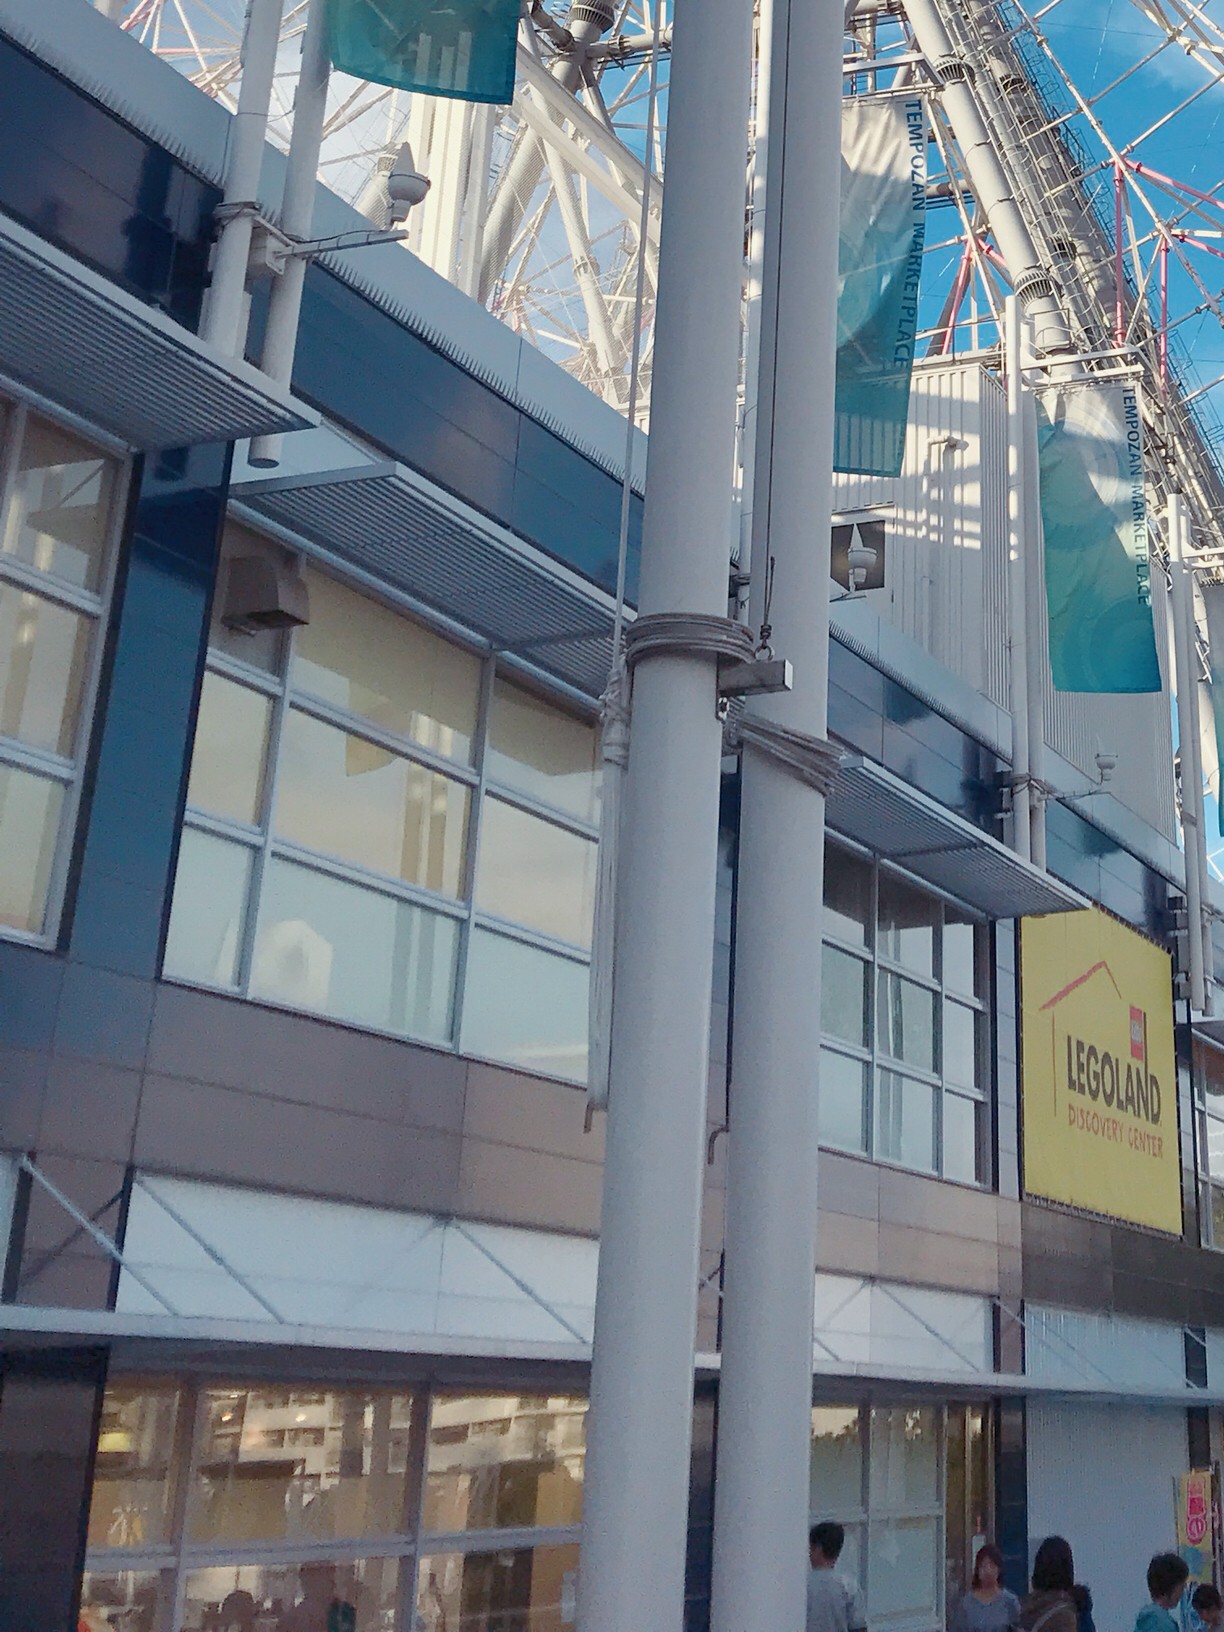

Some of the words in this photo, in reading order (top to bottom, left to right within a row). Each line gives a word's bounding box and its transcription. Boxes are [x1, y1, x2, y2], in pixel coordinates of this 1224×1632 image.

[905, 99, 925, 211] TEMPOZAN
[894, 222, 924, 367] MARKETPLACE
[1122, 385, 1143, 476] TEMPOZAN
[1131, 485, 1150, 605] MARKETPLACE
[1066, 1012, 1161, 1126] LEGOLAND
[1068, 1103, 1124, 1143] DISCOVERY
[1128, 1125, 1163, 1159] CENTER
